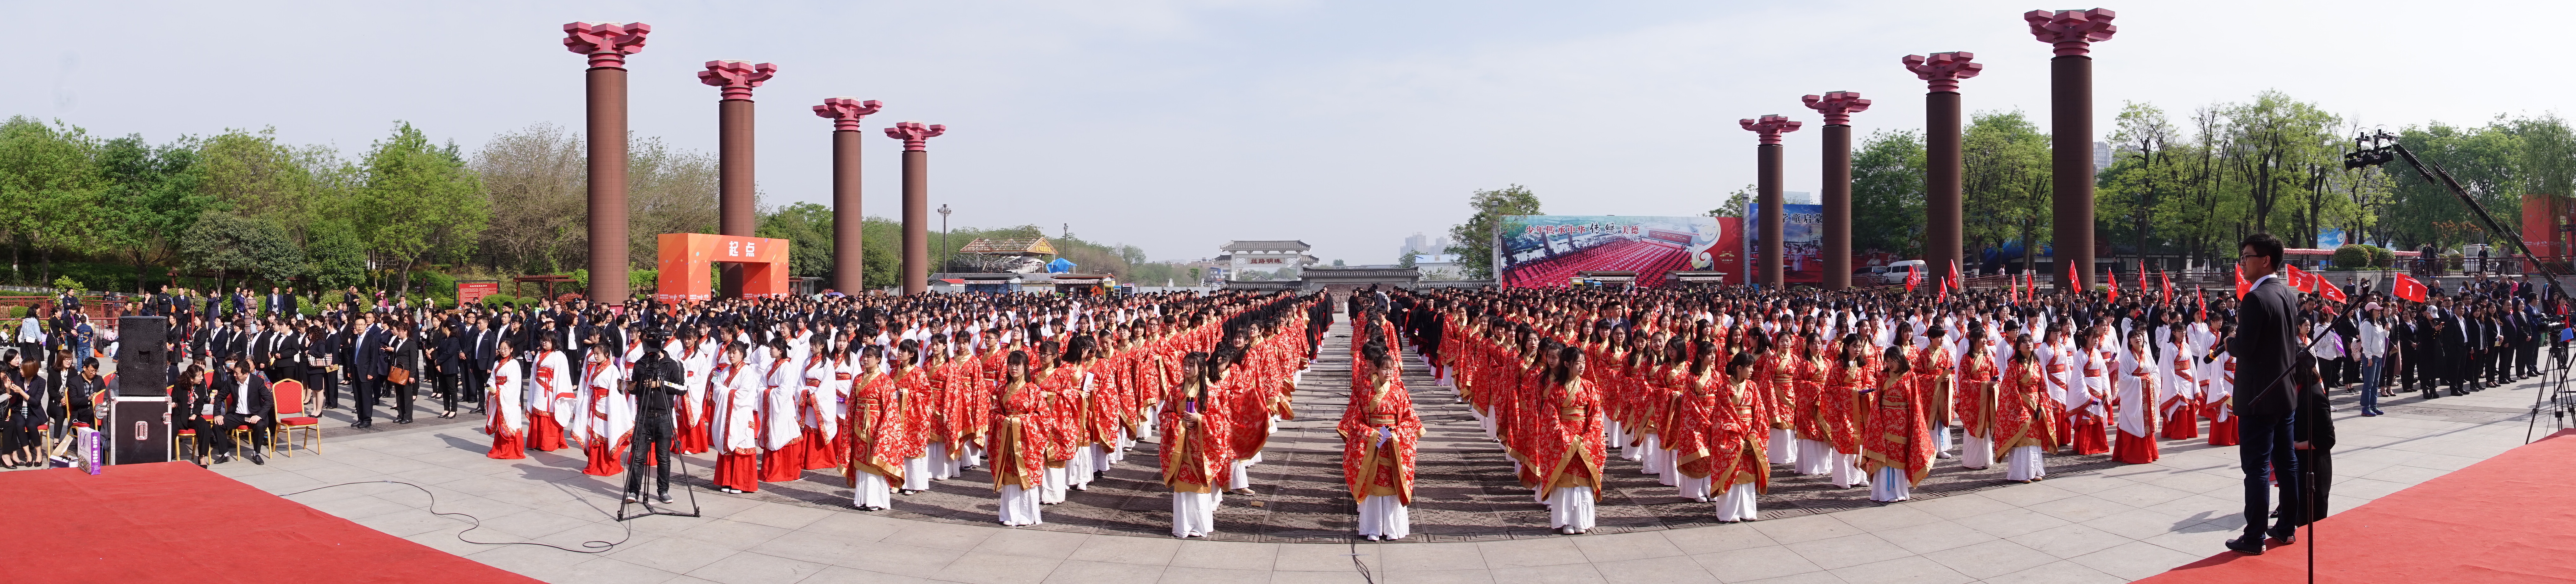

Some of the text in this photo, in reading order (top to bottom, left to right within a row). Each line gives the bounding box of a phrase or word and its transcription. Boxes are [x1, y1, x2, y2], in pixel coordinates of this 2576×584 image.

[1525, 222, 1639, 235] 少年传承中华传统美德
[729, 241, 755, 257] 起点
[2295, 277, 2301, 287] 3
[2327, 288, 2334, 297] 2
[2408, 285, 2412, 296] 1
